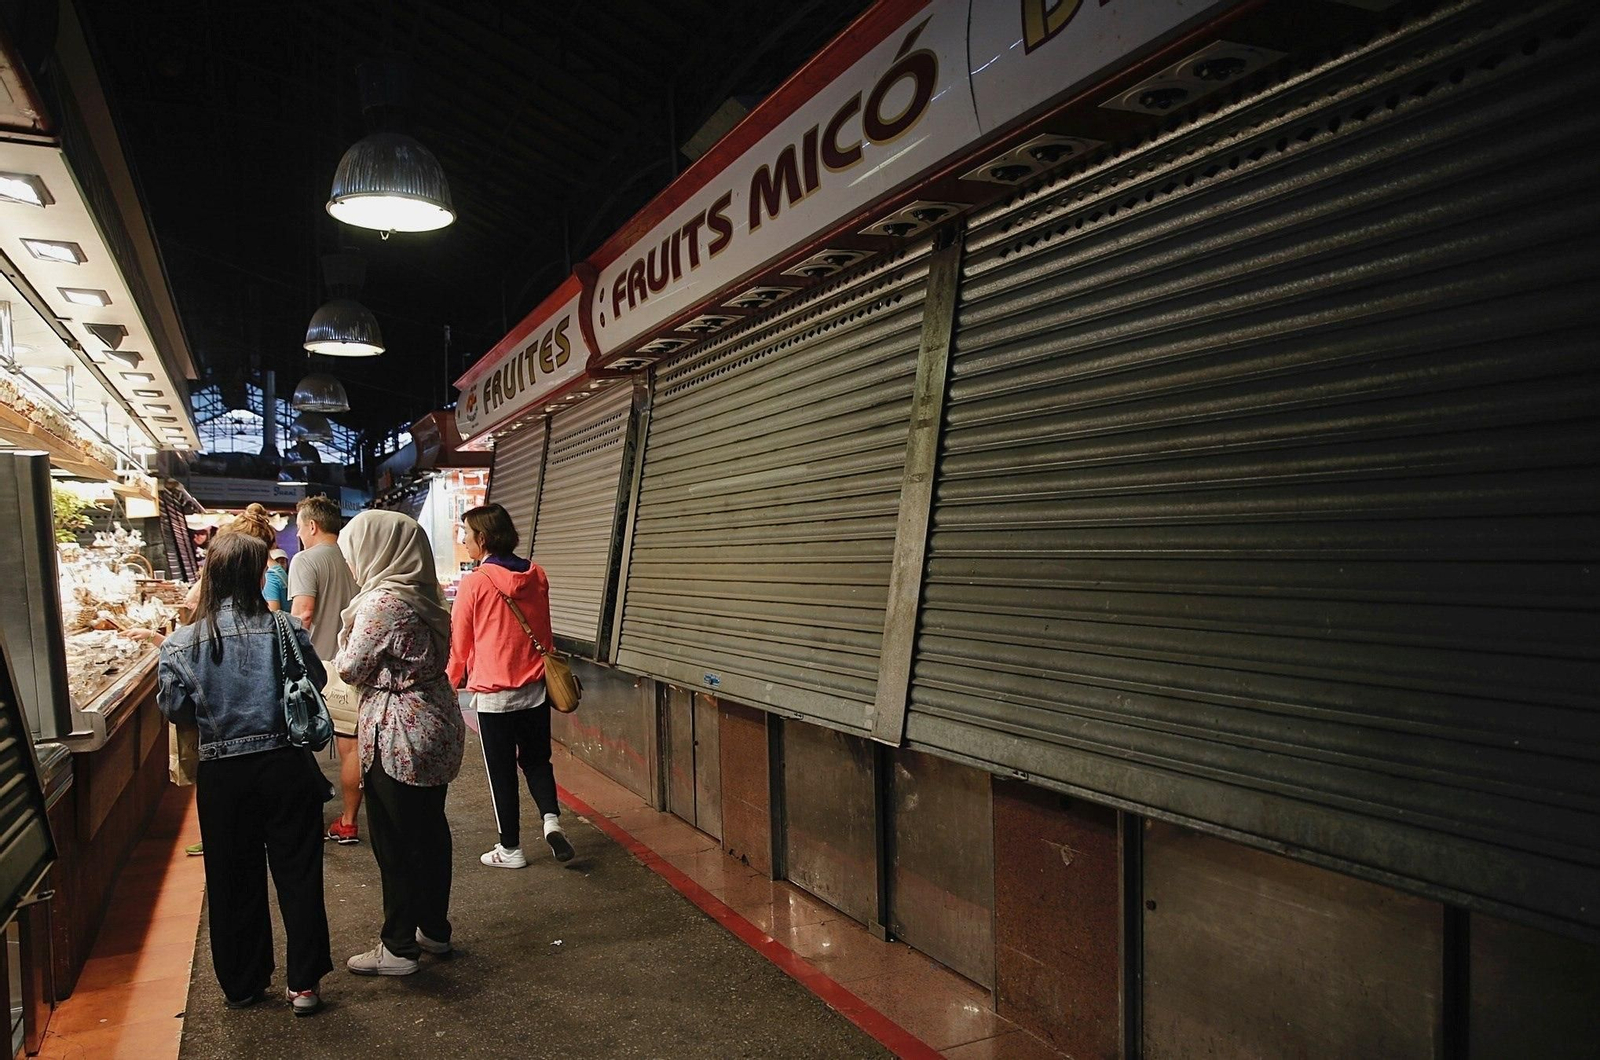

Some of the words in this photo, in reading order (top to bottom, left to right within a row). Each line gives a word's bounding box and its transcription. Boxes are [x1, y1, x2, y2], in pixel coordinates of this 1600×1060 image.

[611, 190, 734, 321] FRUITS
[748, 14, 939, 232] MICÓ
[483, 316, 572, 415] FRUITES
